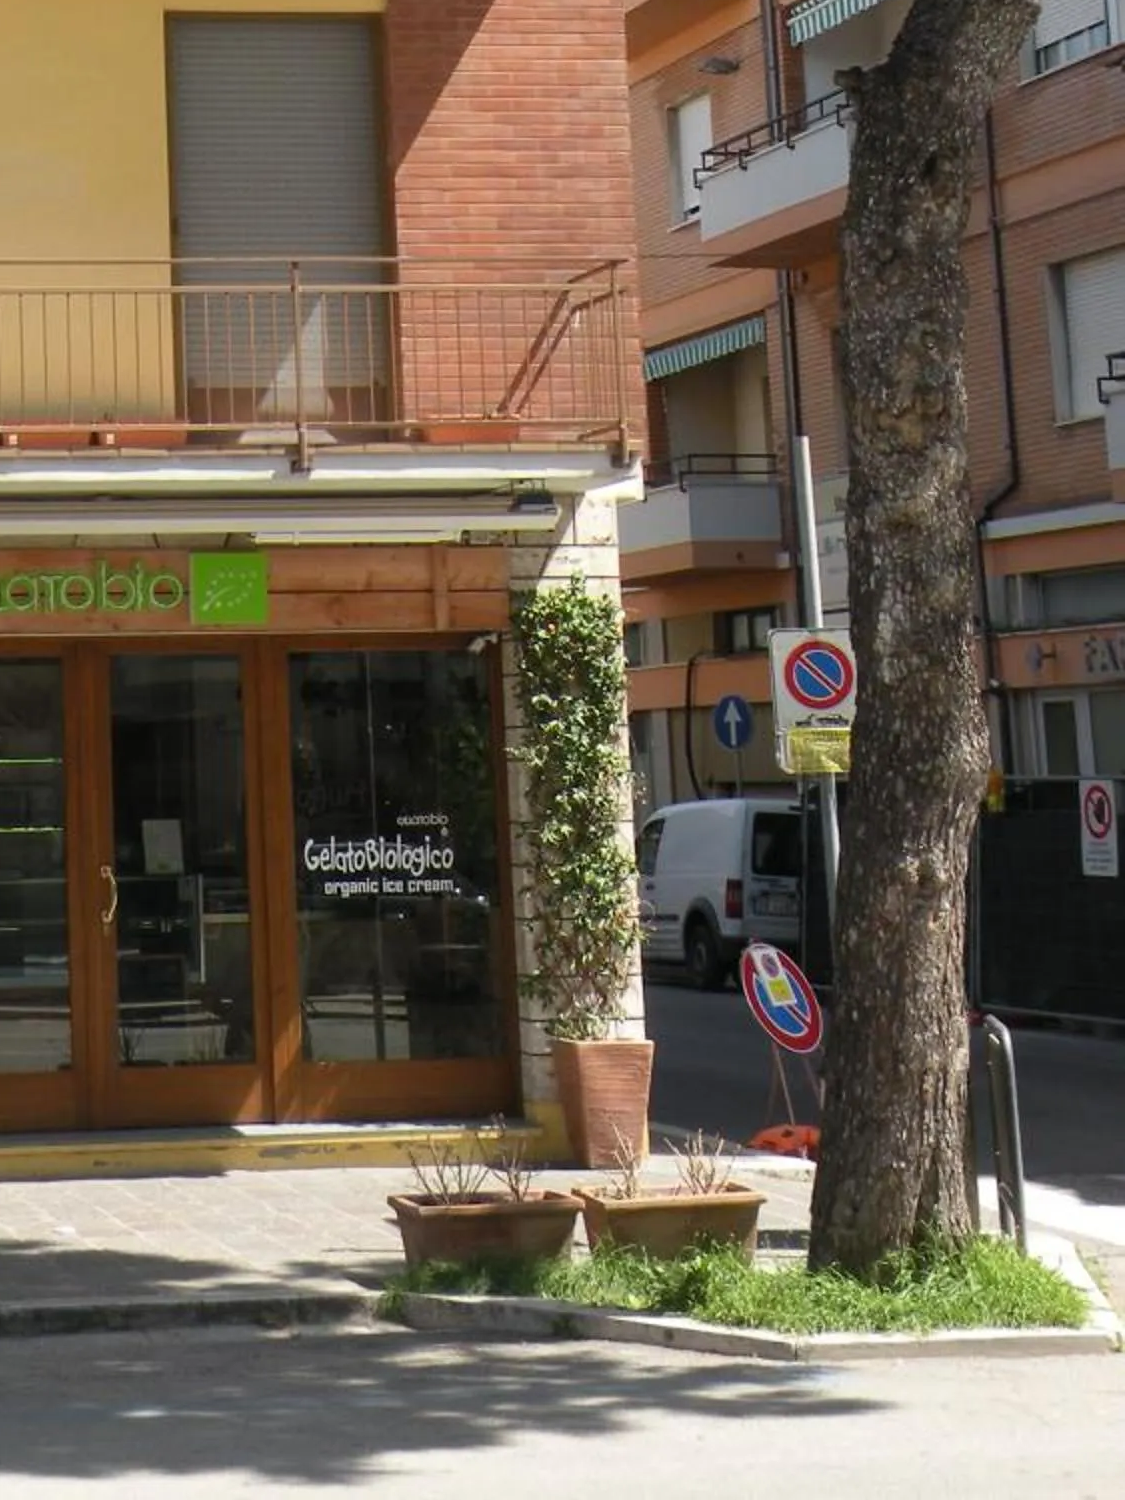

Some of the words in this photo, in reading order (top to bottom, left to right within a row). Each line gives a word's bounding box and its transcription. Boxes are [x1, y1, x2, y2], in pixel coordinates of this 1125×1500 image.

[324, 877, 379, 897] organic
[382, 877, 404, 893] ice
[407, 877, 454, 893] cream
